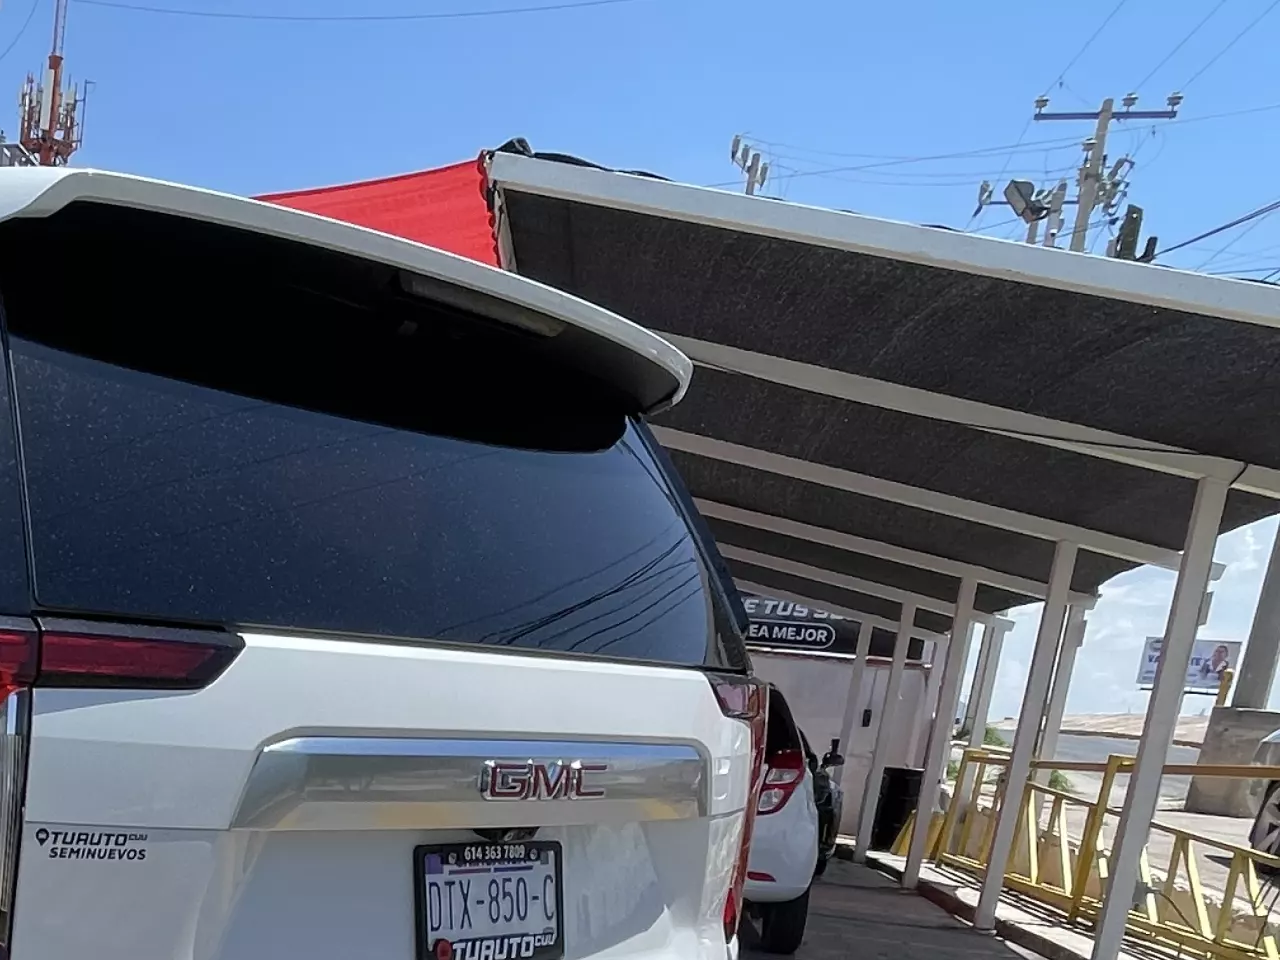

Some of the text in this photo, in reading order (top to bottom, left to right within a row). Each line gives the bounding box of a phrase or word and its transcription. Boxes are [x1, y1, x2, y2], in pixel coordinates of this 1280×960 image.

[764, 600, 809, 618] TUS
[772, 626, 828, 643] MEJOR
[478, 759, 607, 801] GMC
[51, 831, 128, 846] TUAUTO
[49, 847, 147, 860] SEMINUEVOS
[464, 844, 525, 860] 614 363 7809
[534, 933, 556, 946] CUU
